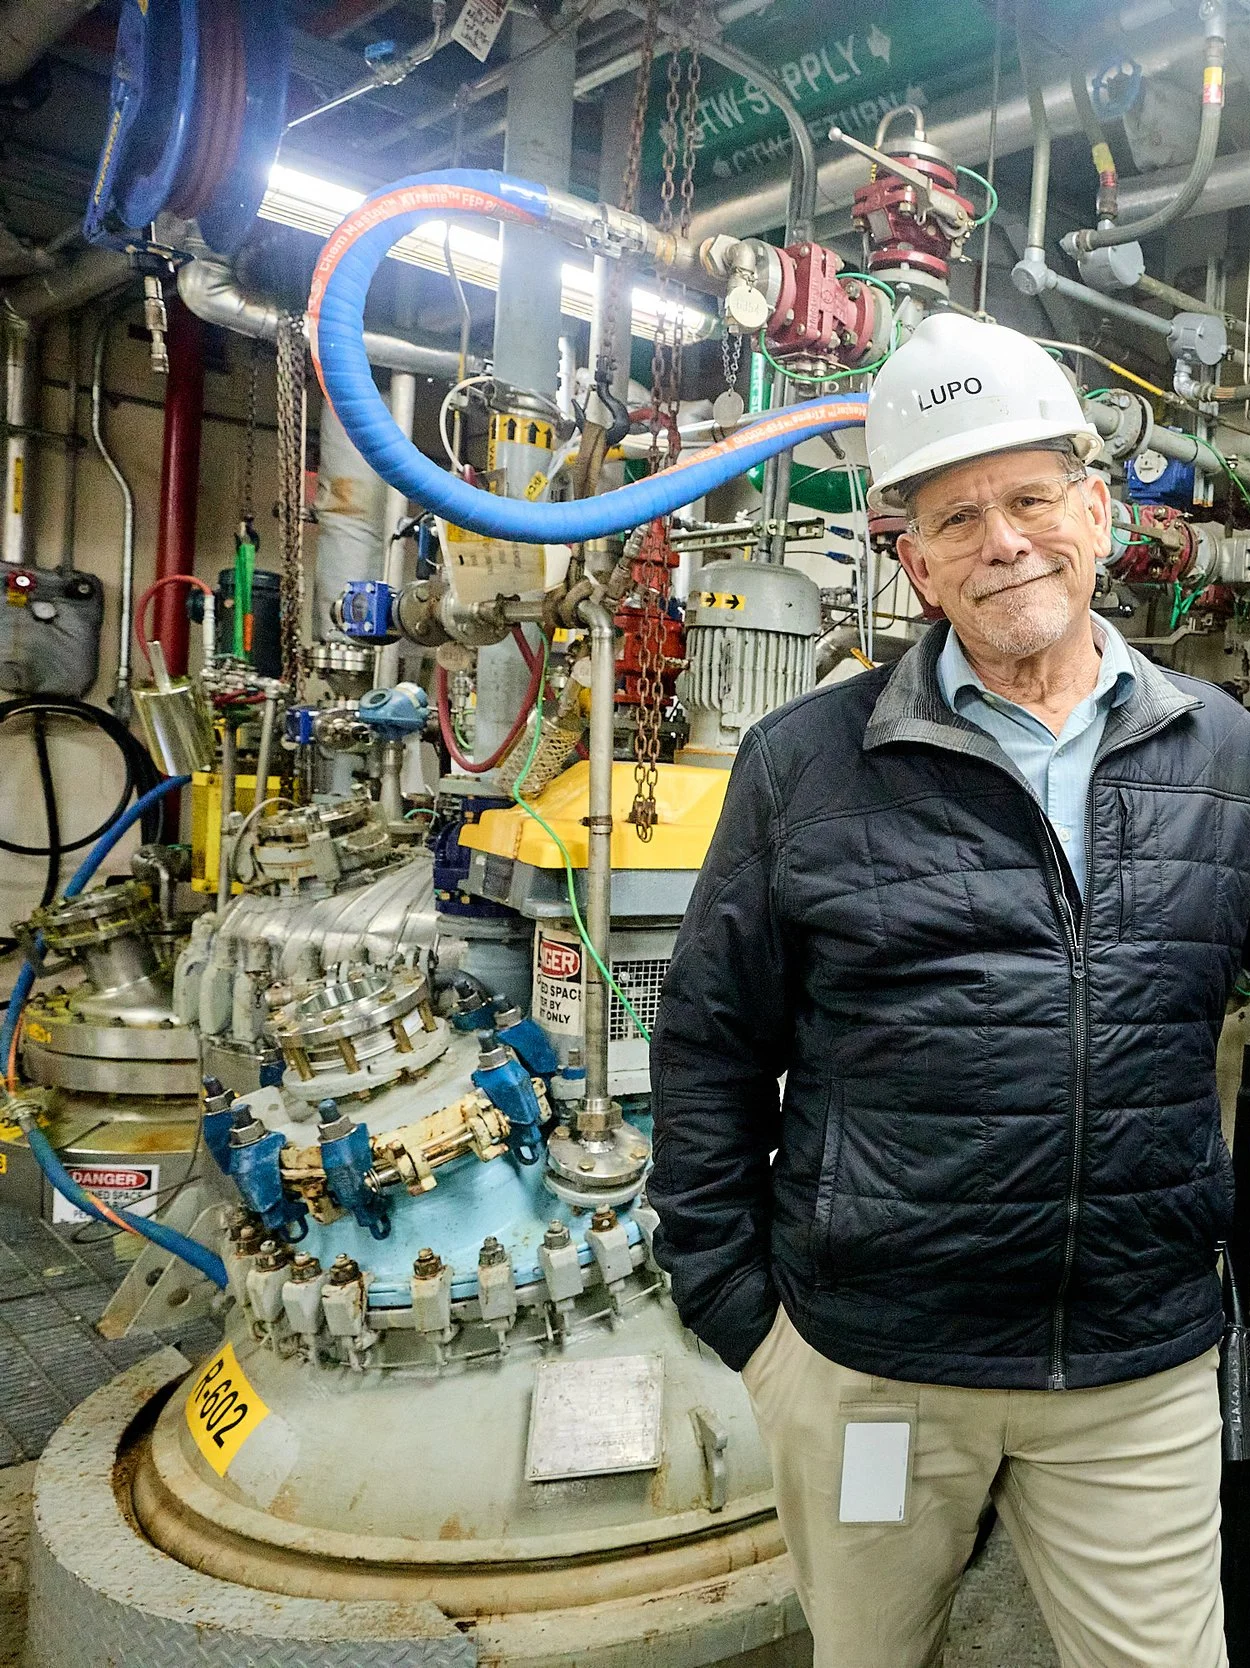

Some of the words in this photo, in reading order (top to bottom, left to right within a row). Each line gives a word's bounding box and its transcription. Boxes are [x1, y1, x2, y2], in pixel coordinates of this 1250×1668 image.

[319, 229, 348, 272] Chem
[461, 193, 485, 208] FEP
[918, 376, 983, 412] LUPO
[543, 948, 575, 973] GER
[549, 1000, 562, 1011] BY
[546, 1011, 571, 1024] ONLY
[72, 1171, 137, 1186] DANGER
[112, 1190, 143, 1200] SPACE
[194, 1357, 248, 1449] R-602
